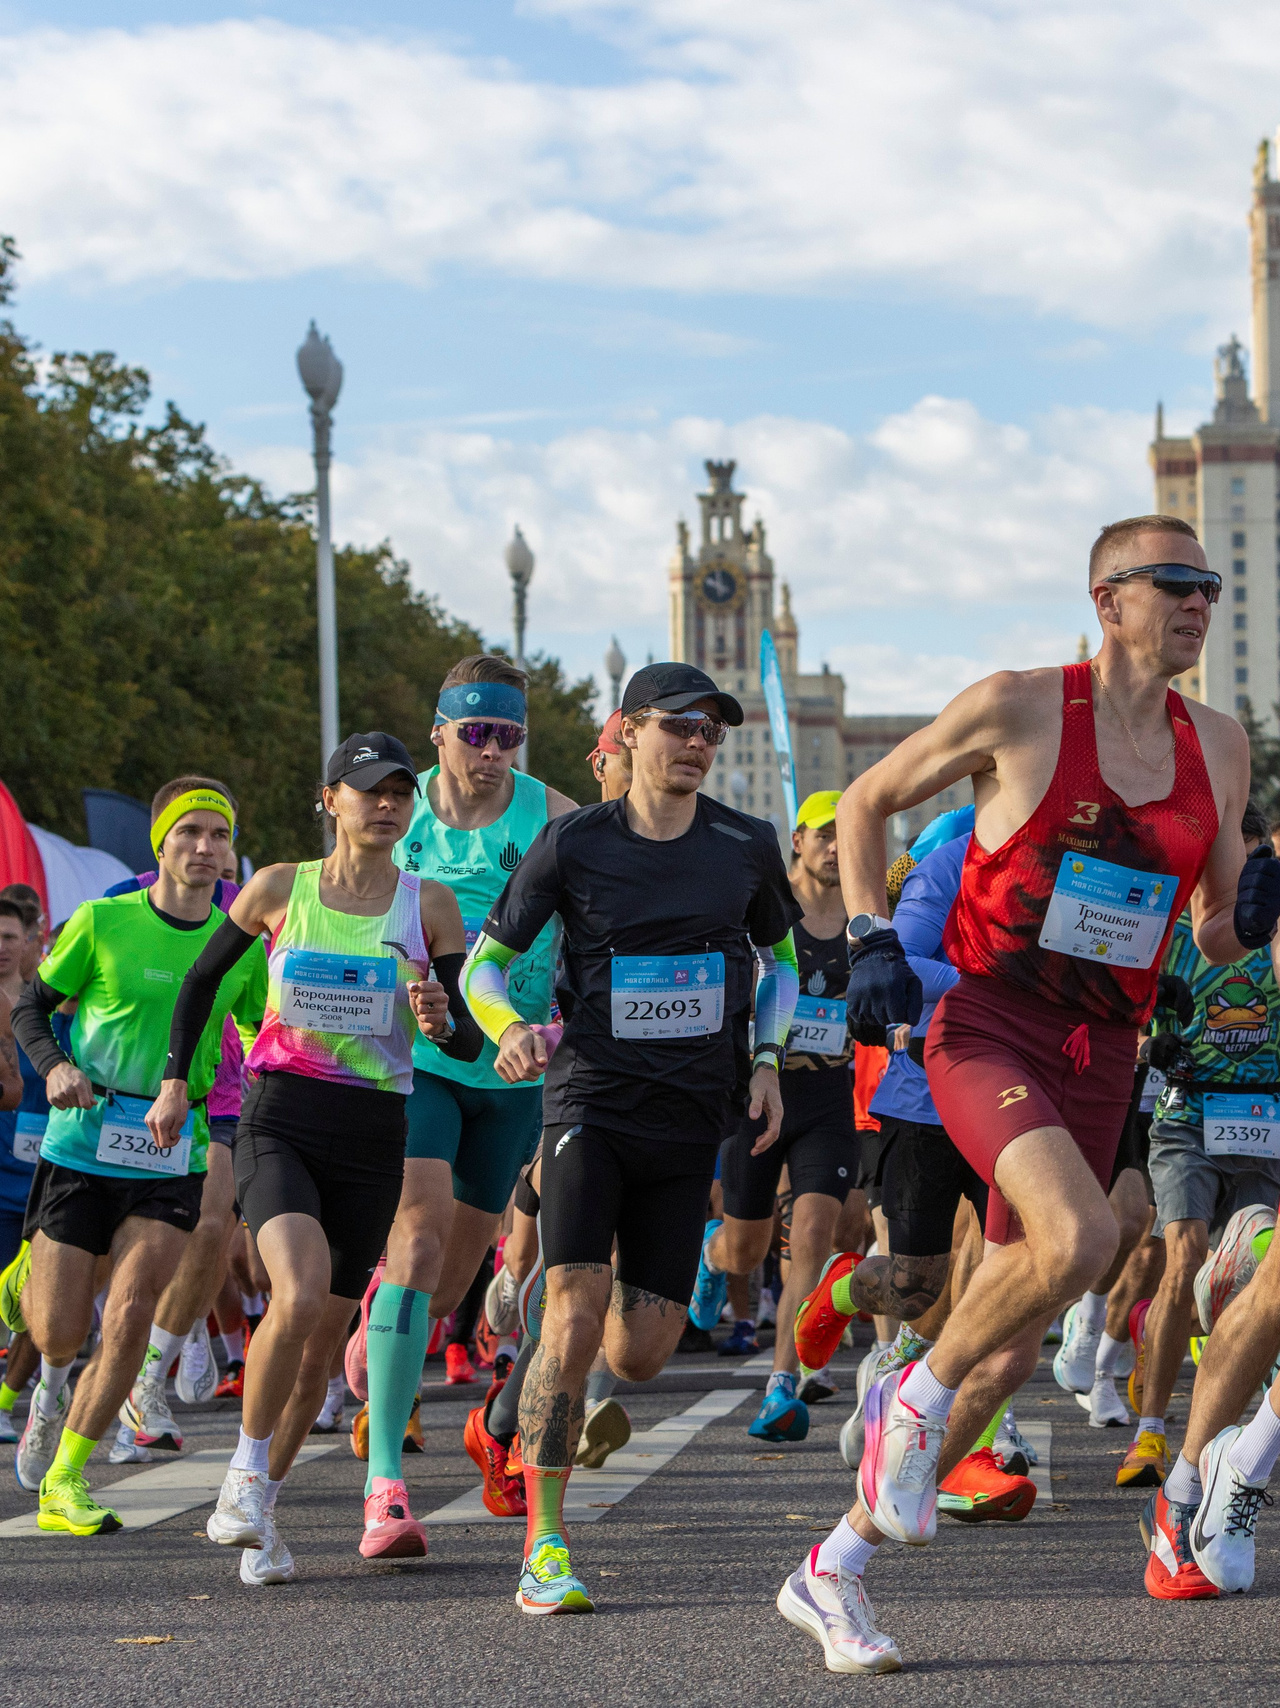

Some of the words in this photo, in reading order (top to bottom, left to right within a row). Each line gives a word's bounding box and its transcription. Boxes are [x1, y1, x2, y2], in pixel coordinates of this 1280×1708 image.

[437, 866, 486, 875] POWERUP
[1071, 880, 1087, 890] МОЯ
[1087, 884, 1122, 899] СТОЛИЦА
[1078, 903, 1140, 929] Трошкин
[1074, 920, 1133, 942] Алексей
[638, 976, 669, 984] СТОЛИЦА
[293, 987, 374, 1004] Бородинова
[293, 998, 372, 1018] Александра
[319, 1013, 342, 1021] 25008
[624, 998, 702, 1020] 22693
[1202, 1027, 1270, 1045] МЫТИЩИ
[1225, 1043, 1250, 1052] БЕГУТ
[1214, 1125, 1271, 1143] 23397
